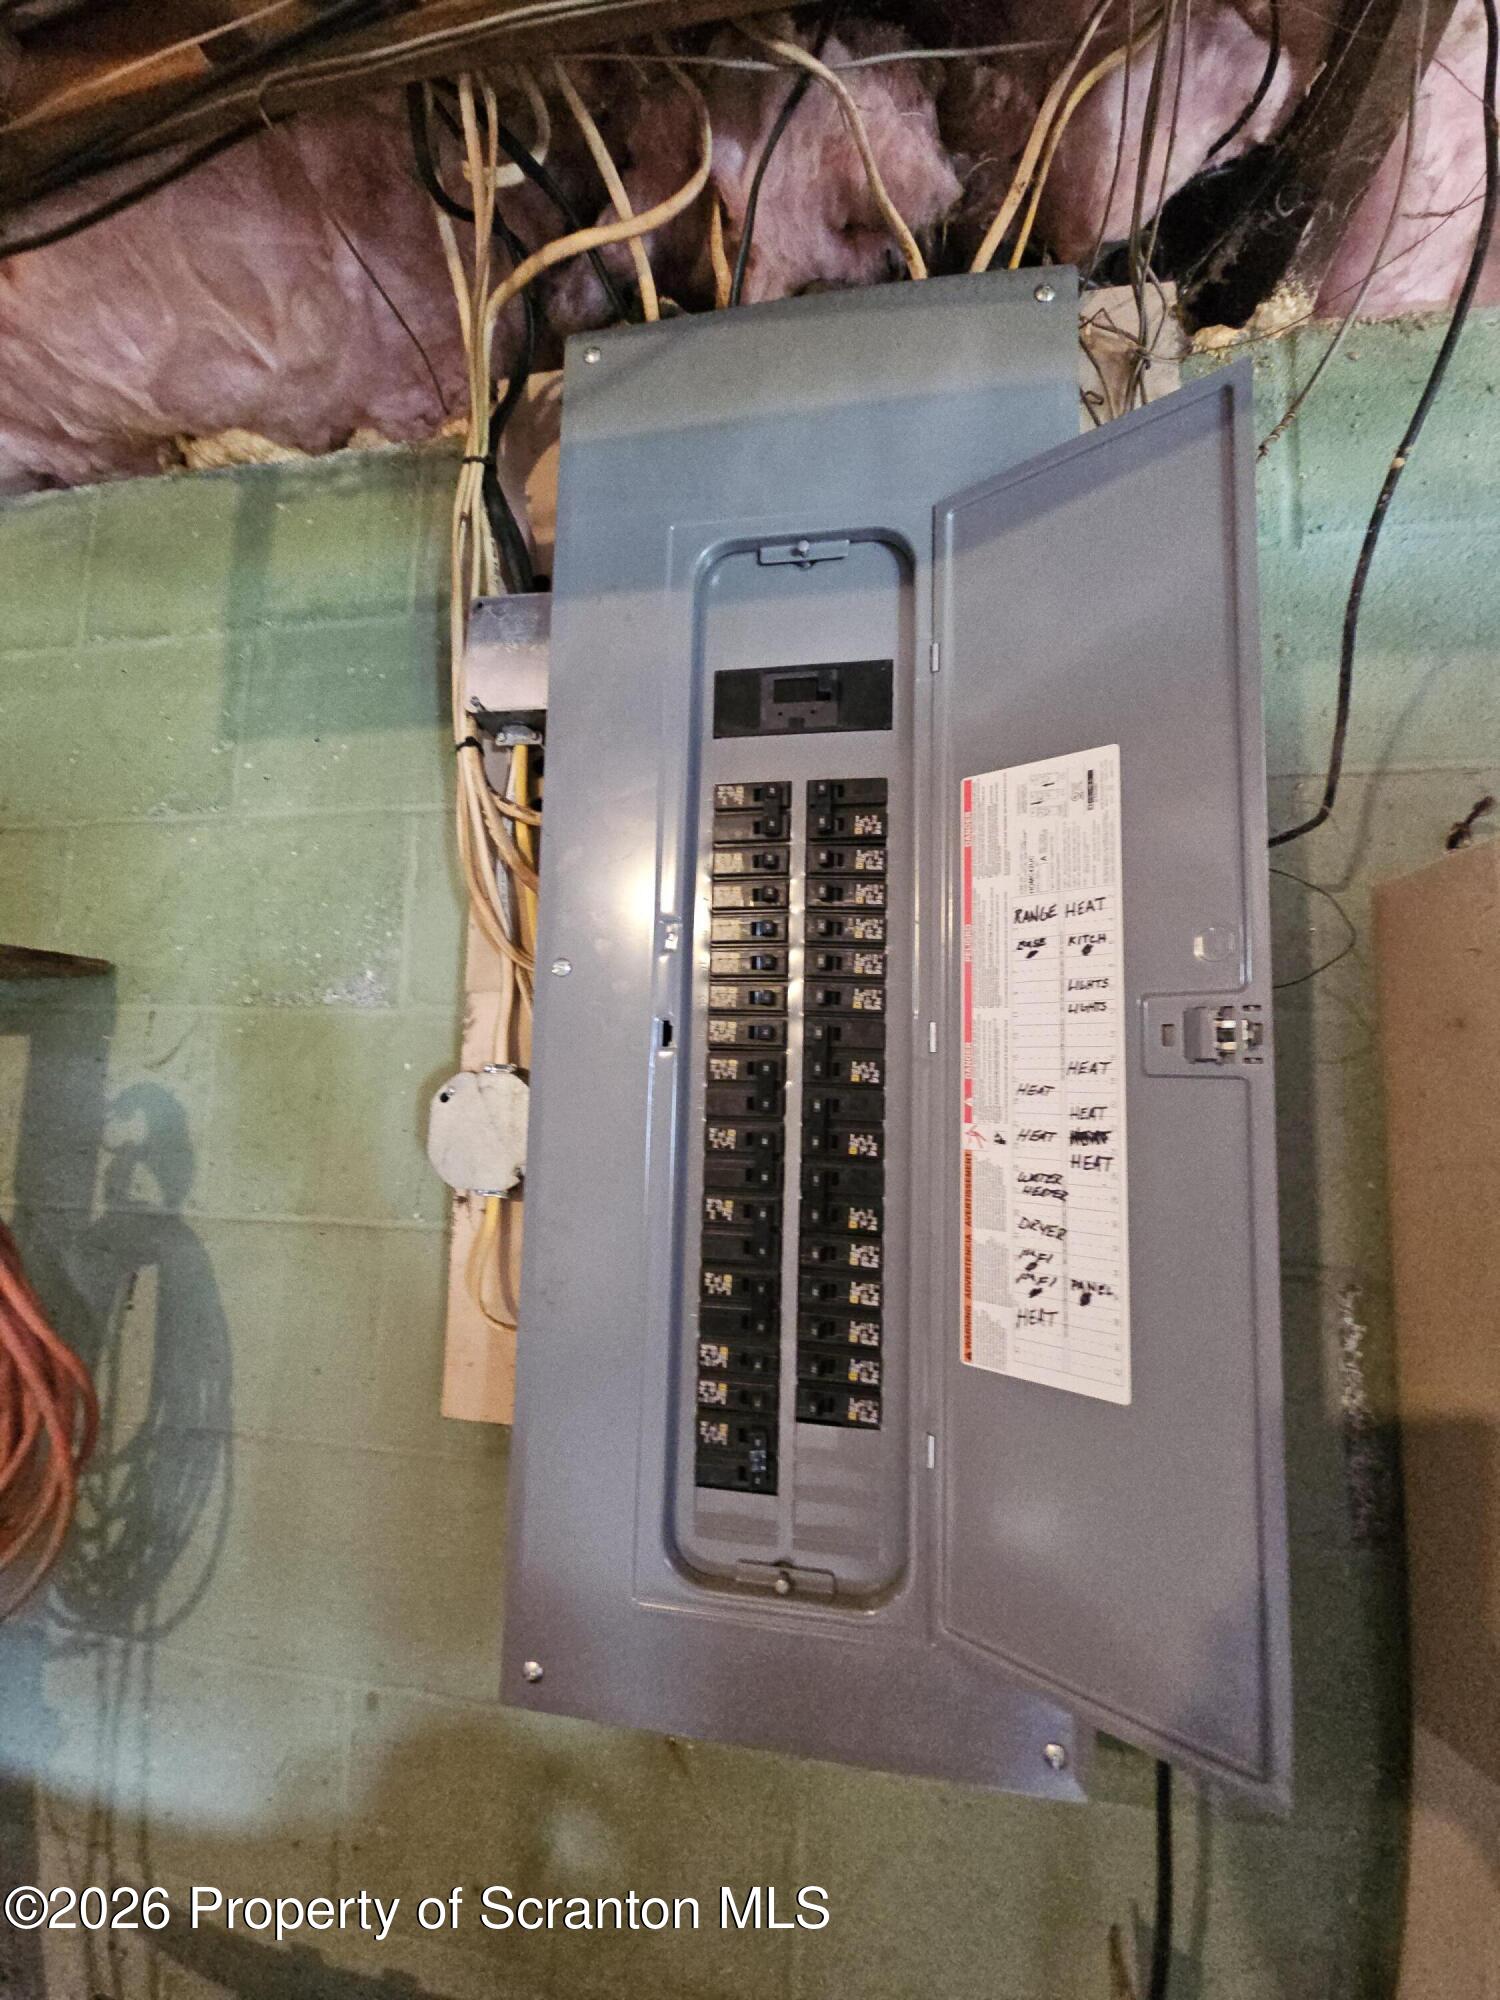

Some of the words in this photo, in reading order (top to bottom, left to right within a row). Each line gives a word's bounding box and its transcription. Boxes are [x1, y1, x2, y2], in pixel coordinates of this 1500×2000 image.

[1014, 904, 1057, 924] RANGE
[1065, 897, 1106, 918] HEAT
[1067, 933, 1107, 948] KITCH
[1067, 978, 1109, 991] LIGHTS
[1067, 1002, 1107, 1014] LIGHTS
[964, 1042, 973, 1079] DANGER
[1066, 1061, 1112, 1076] HEAT
[1016, 1084, 1055, 1096] HEAT
[1069, 1106, 1108, 1121] HEAT
[1016, 1129, 1058, 1142] HEAT
[1070, 1154, 1114, 1172] HEAT
[1017, 1172, 1064, 1185] WATER
[964, 1152, 973, 1227] AVERTISSEMENT
[1018, 1216, 1068, 1241] DRYER
[964, 1234, 973, 1299] ADVERTENCIA
[964, 1305, 973, 1349] WARNING
[1016, 1308, 1058, 1328] HEAT
